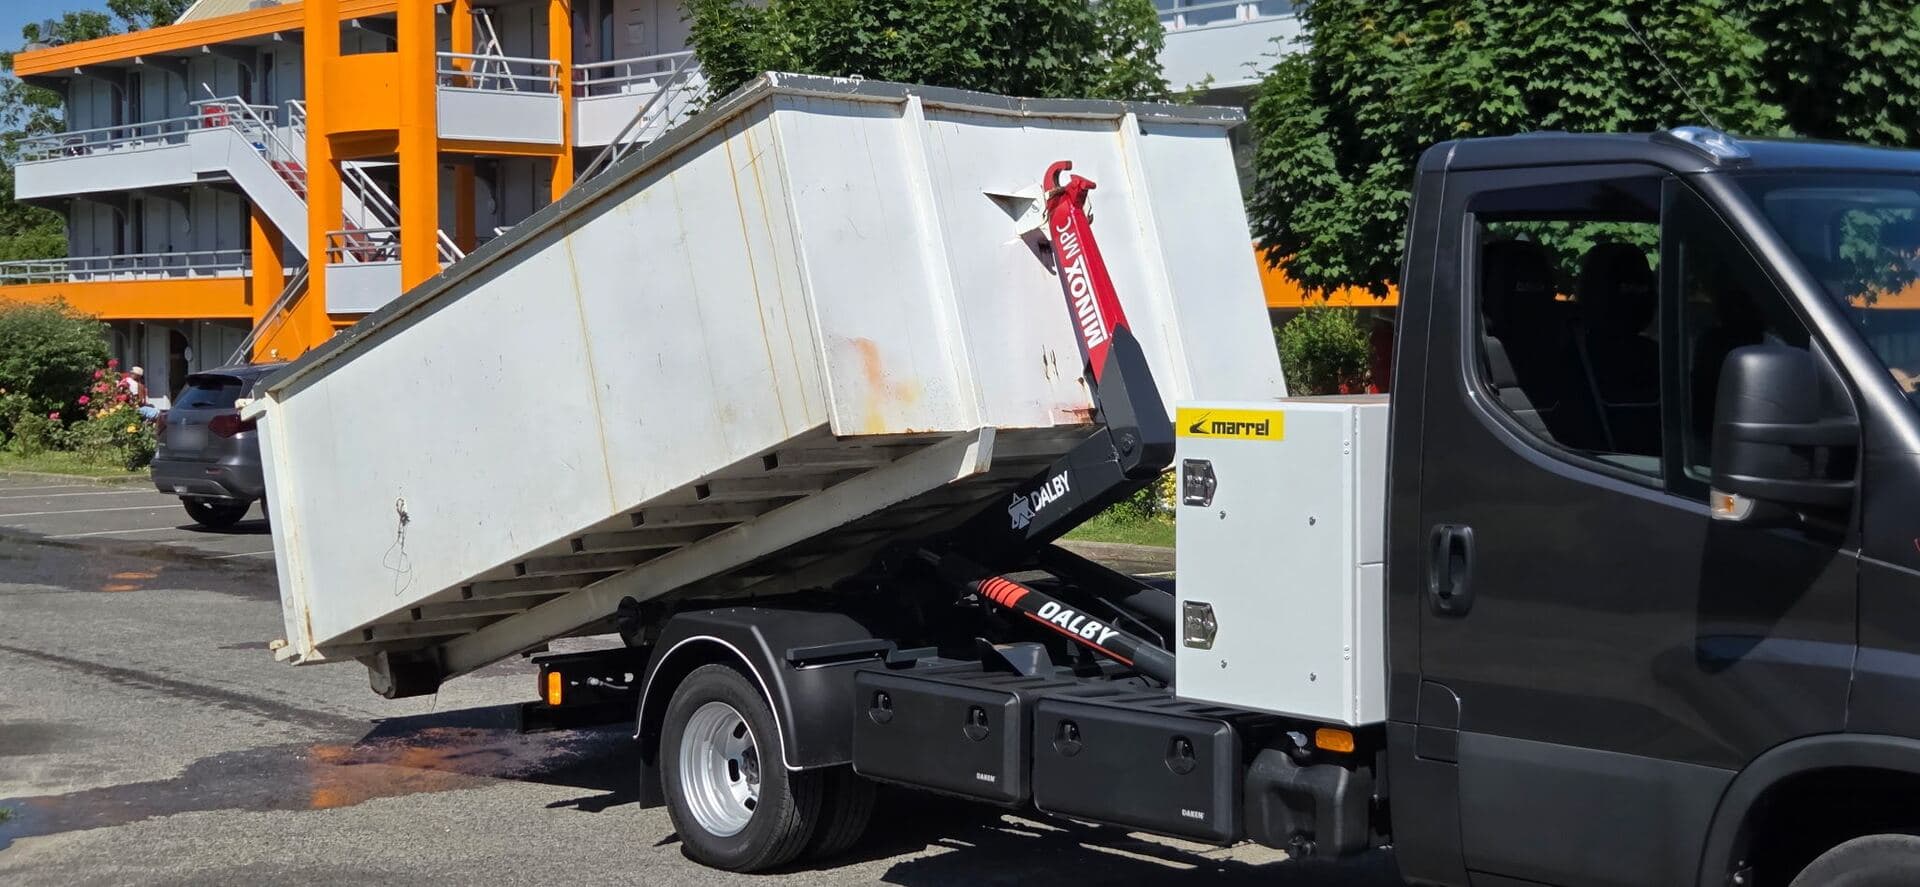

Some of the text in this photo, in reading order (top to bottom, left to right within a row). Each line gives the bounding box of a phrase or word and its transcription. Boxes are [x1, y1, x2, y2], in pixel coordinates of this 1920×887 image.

[1056, 216, 1104, 349] MINOX MPC
[1211, 418, 1270, 436] marrel
[1030, 470, 1070, 511] DALBY
[1037, 601, 1120, 645] DALBY
